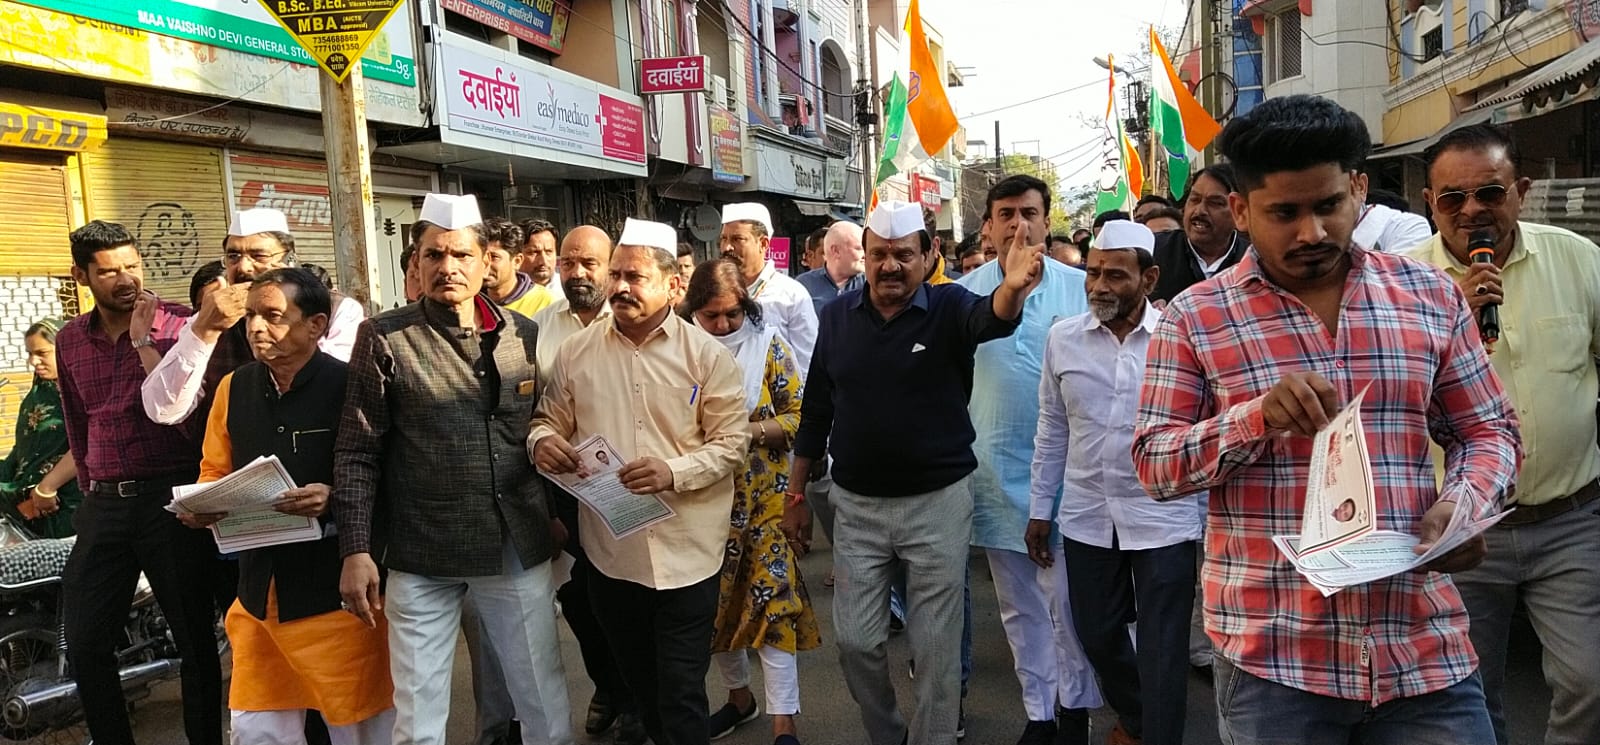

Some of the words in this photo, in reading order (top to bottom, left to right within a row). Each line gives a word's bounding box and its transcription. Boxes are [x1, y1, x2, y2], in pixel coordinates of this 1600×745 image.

[278, 1, 310, 13] B.Sc.
[446, 0, 511, 32] ENTERPRISES
[138, 10, 165, 28] MAA
[166, 17, 216, 39] VAISHNO
[218, 31, 243, 46] DEVI
[244, 35, 289, 56] GENERAL
[298, 16, 338, 33] MBA
[313, 43, 360, 53] 7771001350
[646, 61, 699, 87] दवाईयाँ
[459, 67, 520, 119] दवाईयाँ
